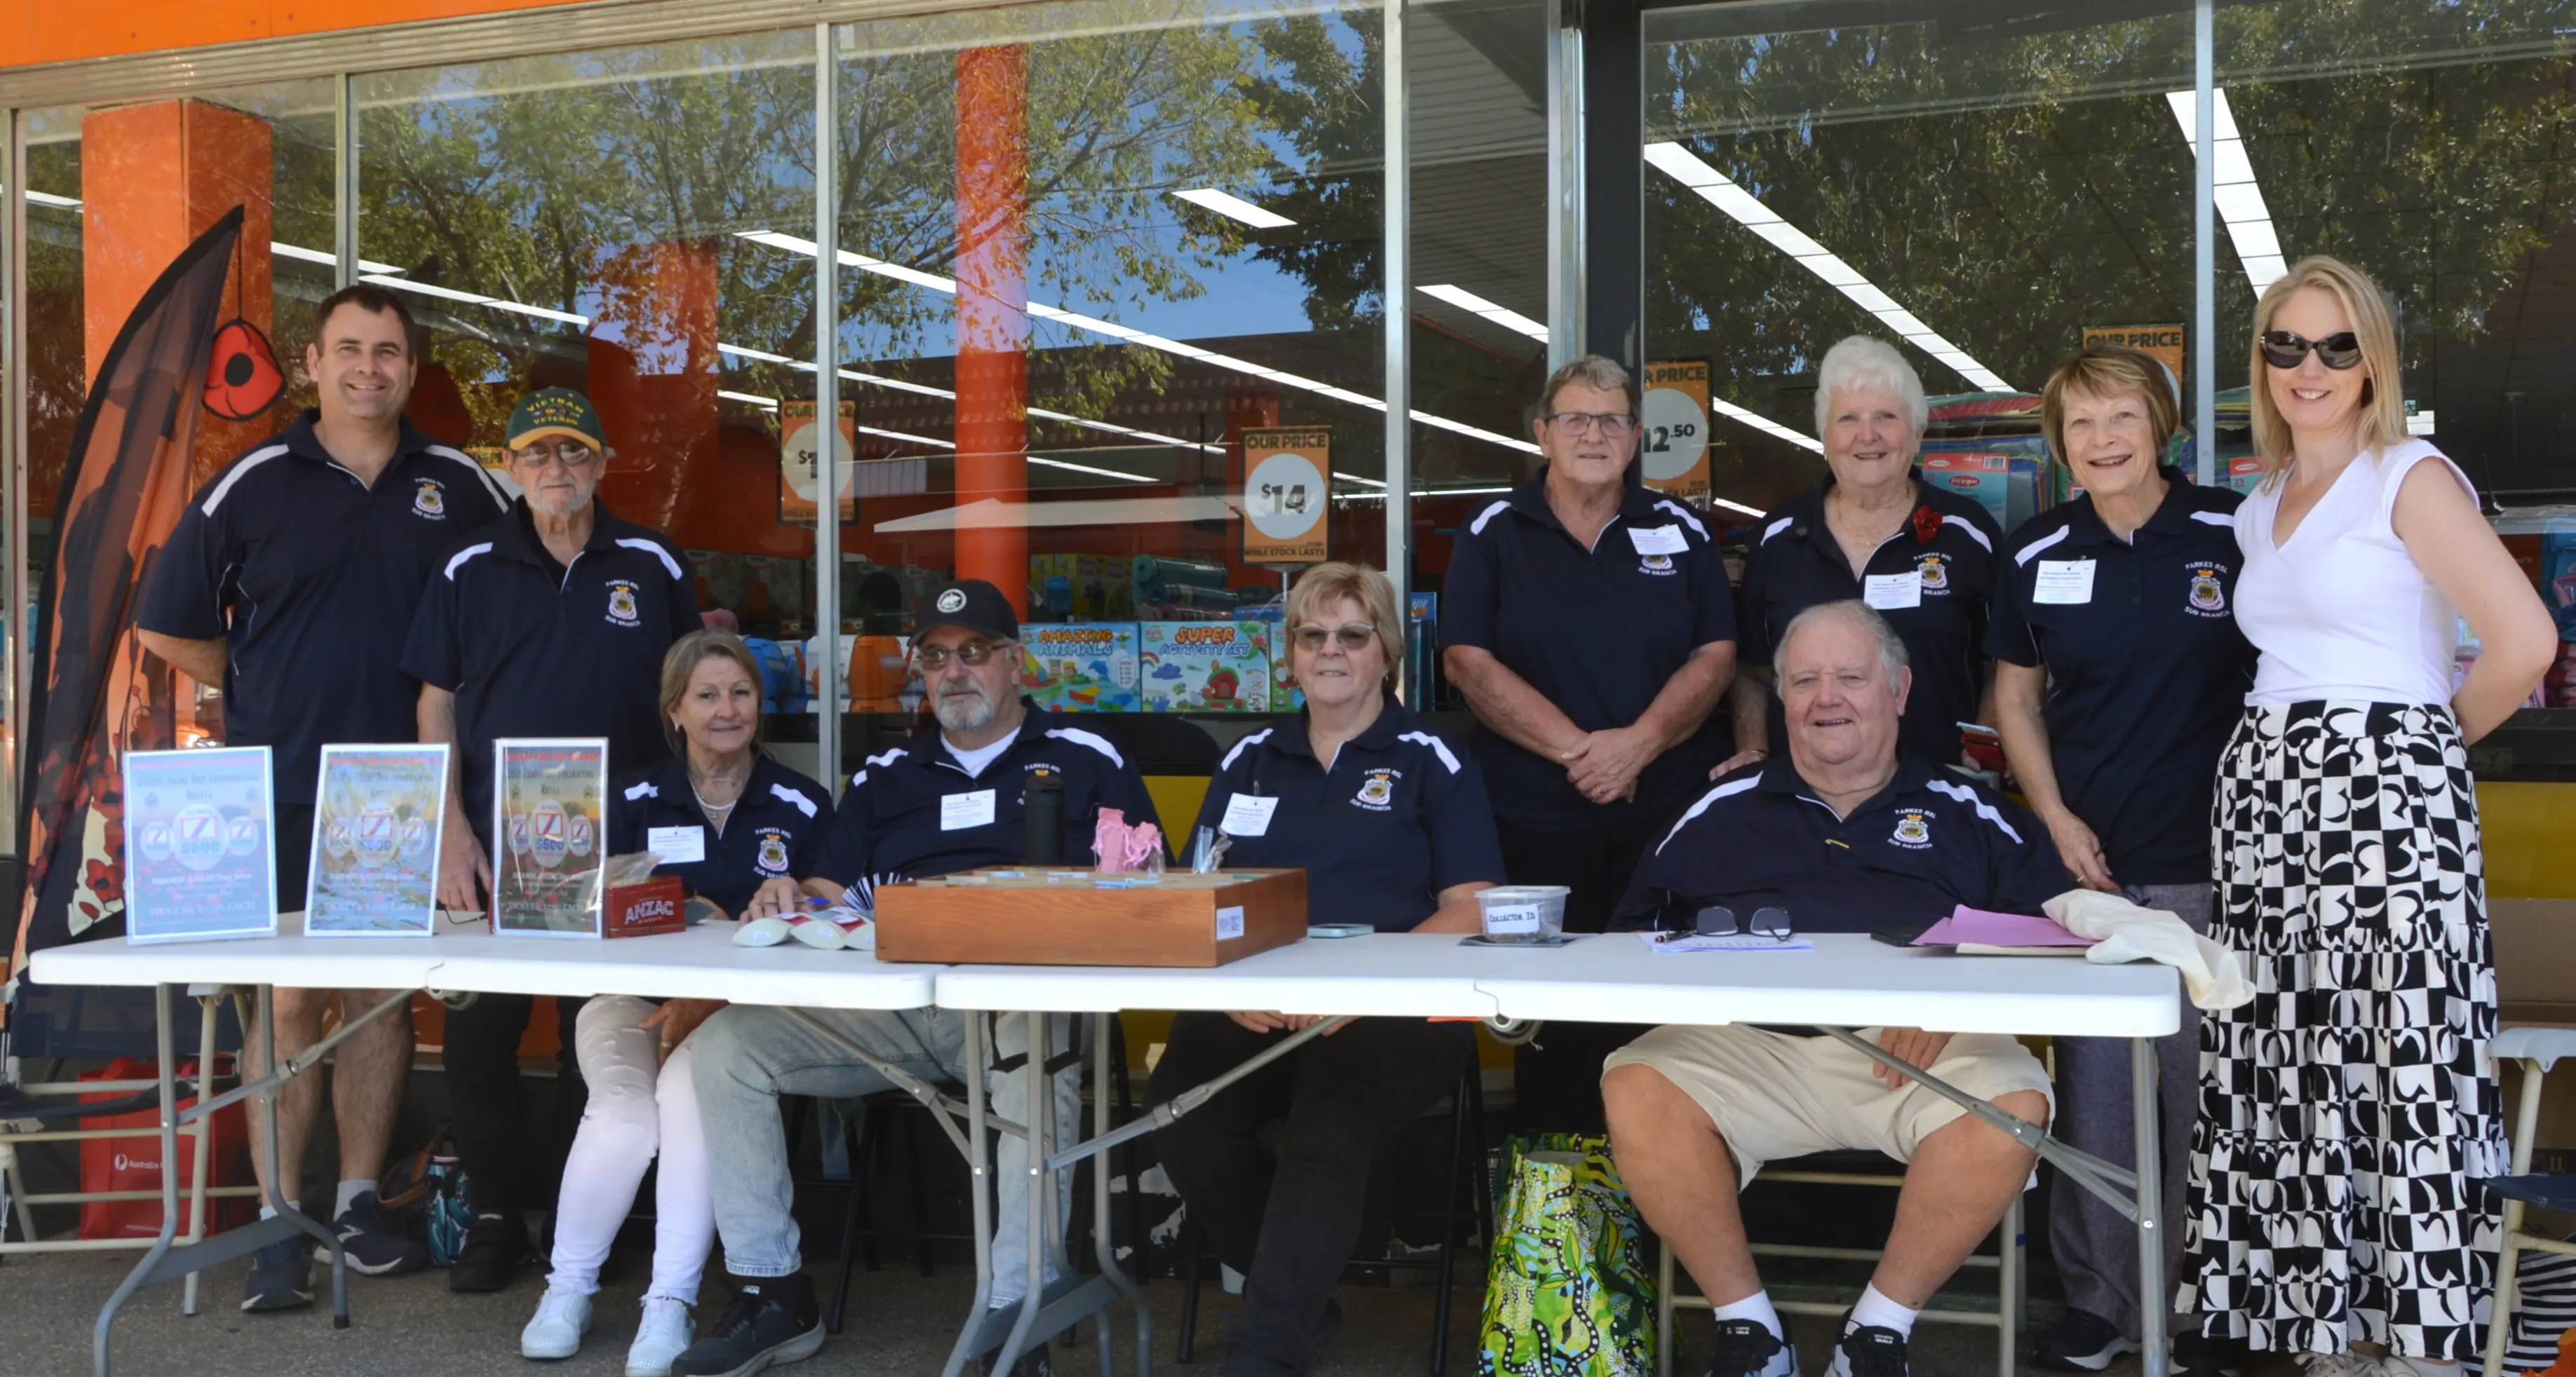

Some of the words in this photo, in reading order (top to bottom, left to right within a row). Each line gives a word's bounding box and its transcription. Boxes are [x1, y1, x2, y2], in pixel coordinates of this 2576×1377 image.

[2129, 332, 2181, 347] PRICE
[1657, 366, 1706, 383] PRICE
[527, 397, 584, 414] VIETNAM
[783, 405, 812, 418] OUR
[533, 415, 579, 426] VETERAN
[1246, 435, 1280, 449] OUR
[1282, 433, 1326, 449] PRICE
[1643, 423, 1696, 453] 12.50
[798, 449, 818, 480] $1
[1261, 482, 1307, 515] $14
[1243, 548, 1267, 557] WHILE
[1269, 547, 1297, 557] STOCK
[1298, 547, 1326, 557] LASTS
[1913, 552, 1940, 561] PARKES
[2185, 561, 2213, 571] PARKES
[2214, 563, 2227, 574] RSL
[2184, 606, 2199, 616] SUB
[2200, 609, 2231, 618] BRANCH
[1037, 628, 1114, 643] AMAZING
[1175, 626, 1236, 644] SUPER
[1037, 642, 1114, 656] ANIMALS
[1159, 643, 1225, 656] ACTIVITY
[1225, 643, 1250, 655] SET
[1024, 762, 1050, 771] PARKES
[1924, 810, 1936, 819] RSL
[624, 900, 674, 925] ANZAC
[1489, 913, 1523, 923] COLLECTOR
[1525, 911, 1536, 921] ID
[128, 1159, 160, 1169] Australia
